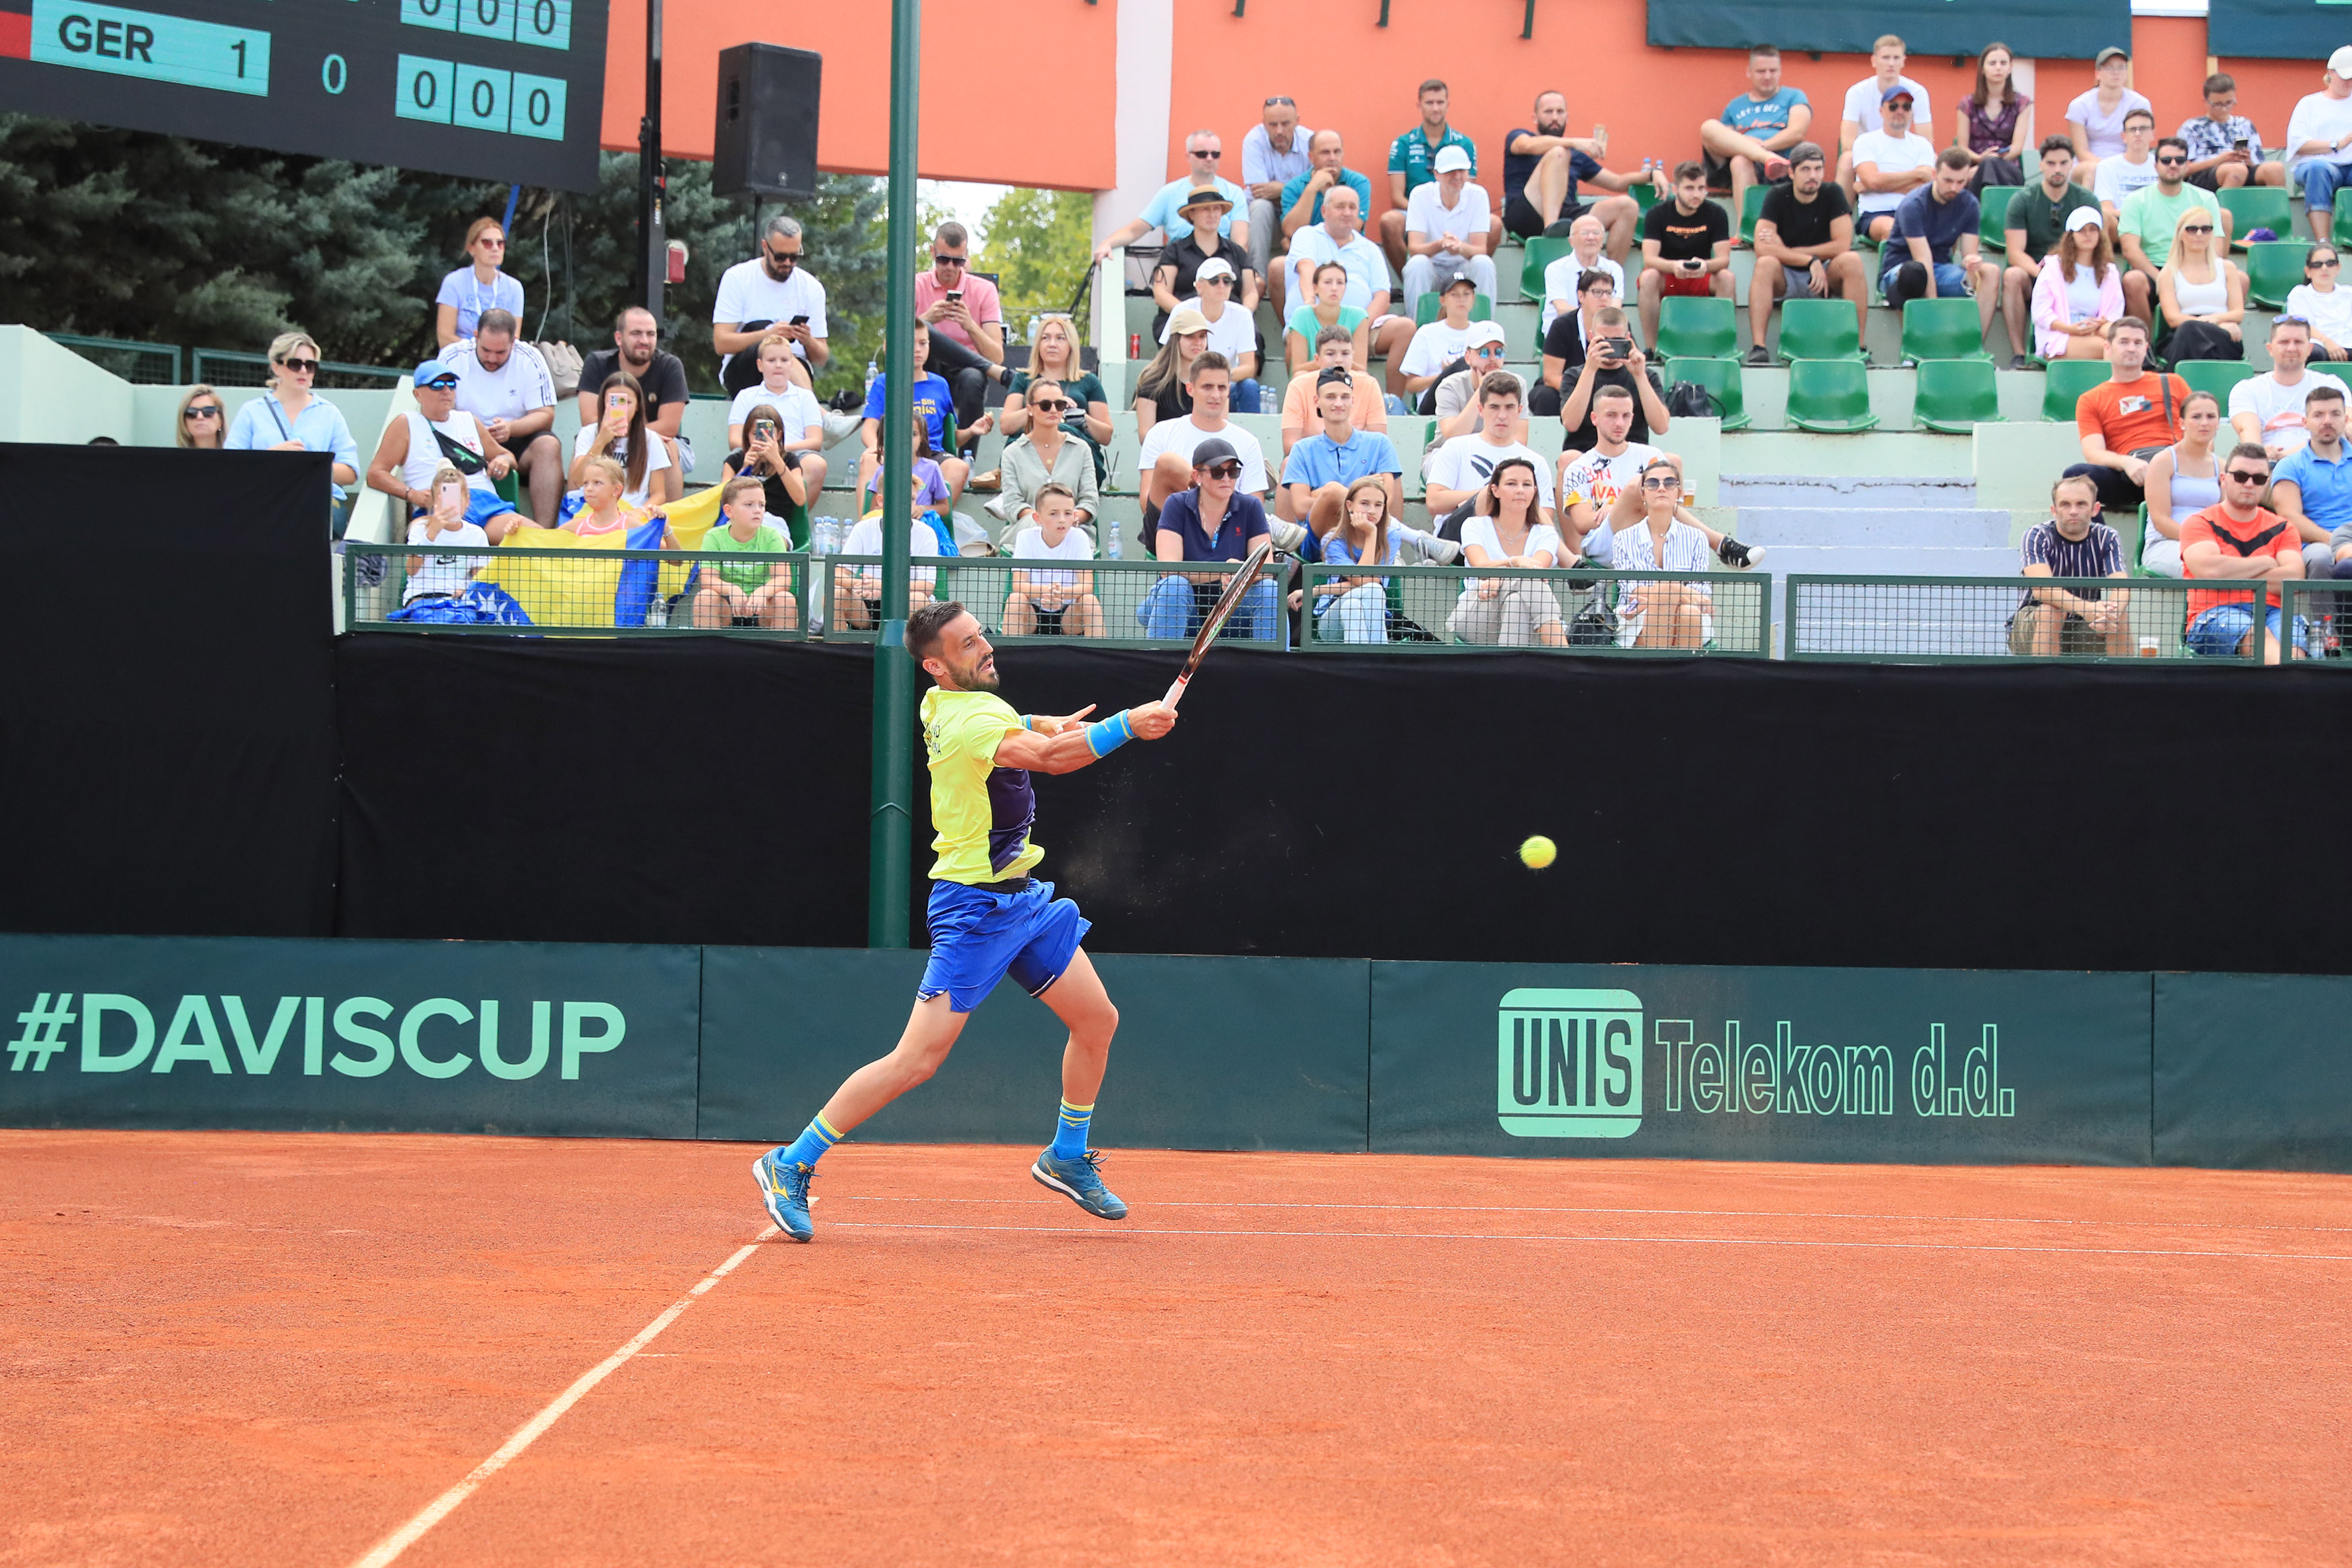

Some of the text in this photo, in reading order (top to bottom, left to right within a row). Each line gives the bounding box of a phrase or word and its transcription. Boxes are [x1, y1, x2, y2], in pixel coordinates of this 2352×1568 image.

[534, 0, 556, 35] 0
[58, 15, 550, 126] GER 1 0 0 0 0
[7, 992, 626, 1080] #DAVISCUP
[1513, 1018, 2015, 1117] UNIS Telekom d.d.
